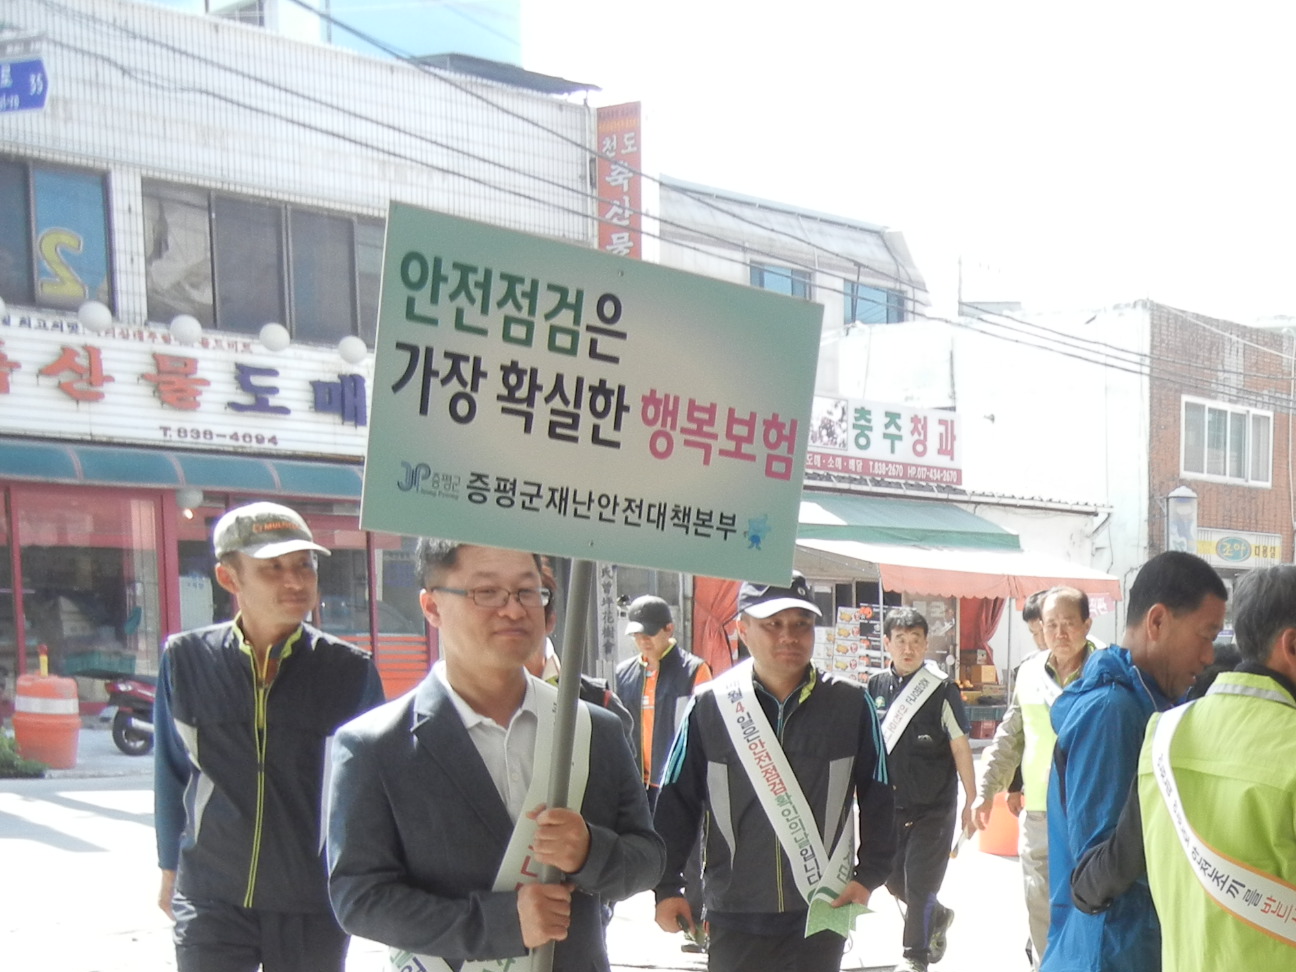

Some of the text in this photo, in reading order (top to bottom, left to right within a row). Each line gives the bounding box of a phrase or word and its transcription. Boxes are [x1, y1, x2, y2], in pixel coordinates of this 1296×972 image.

[400, 251, 628, 364] 안전점검은
[226, 362, 367, 428] 도매
[391, 341, 799, 481] 가장 확실한 행복보험
[852, 406, 957, 462] 충주청과
